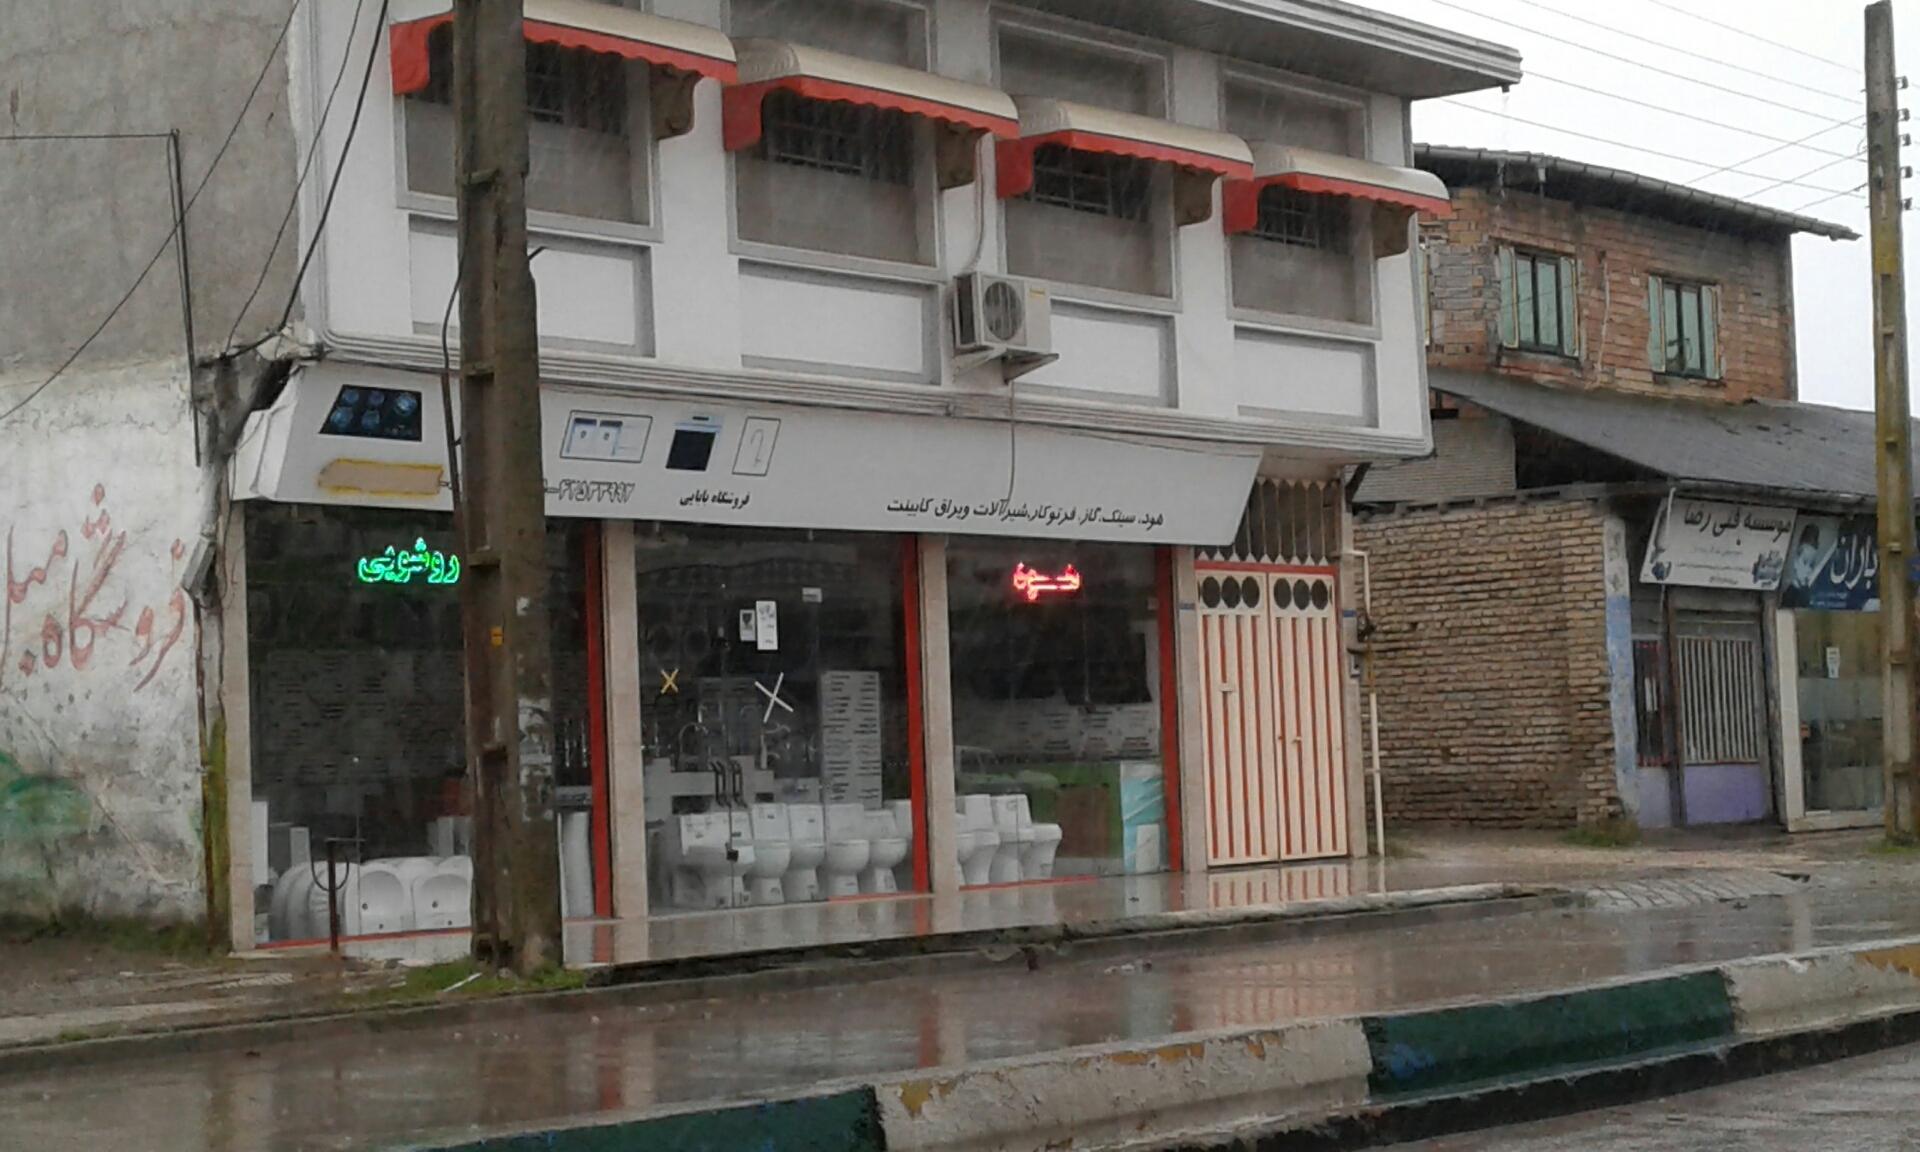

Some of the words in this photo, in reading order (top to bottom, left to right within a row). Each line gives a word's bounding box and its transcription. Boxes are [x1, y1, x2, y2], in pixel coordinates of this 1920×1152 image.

[711, 490, 750, 509] فروشگاه
[886, 498, 933, 518] کابینت
[40, 482, 186, 692] فروشگاه
